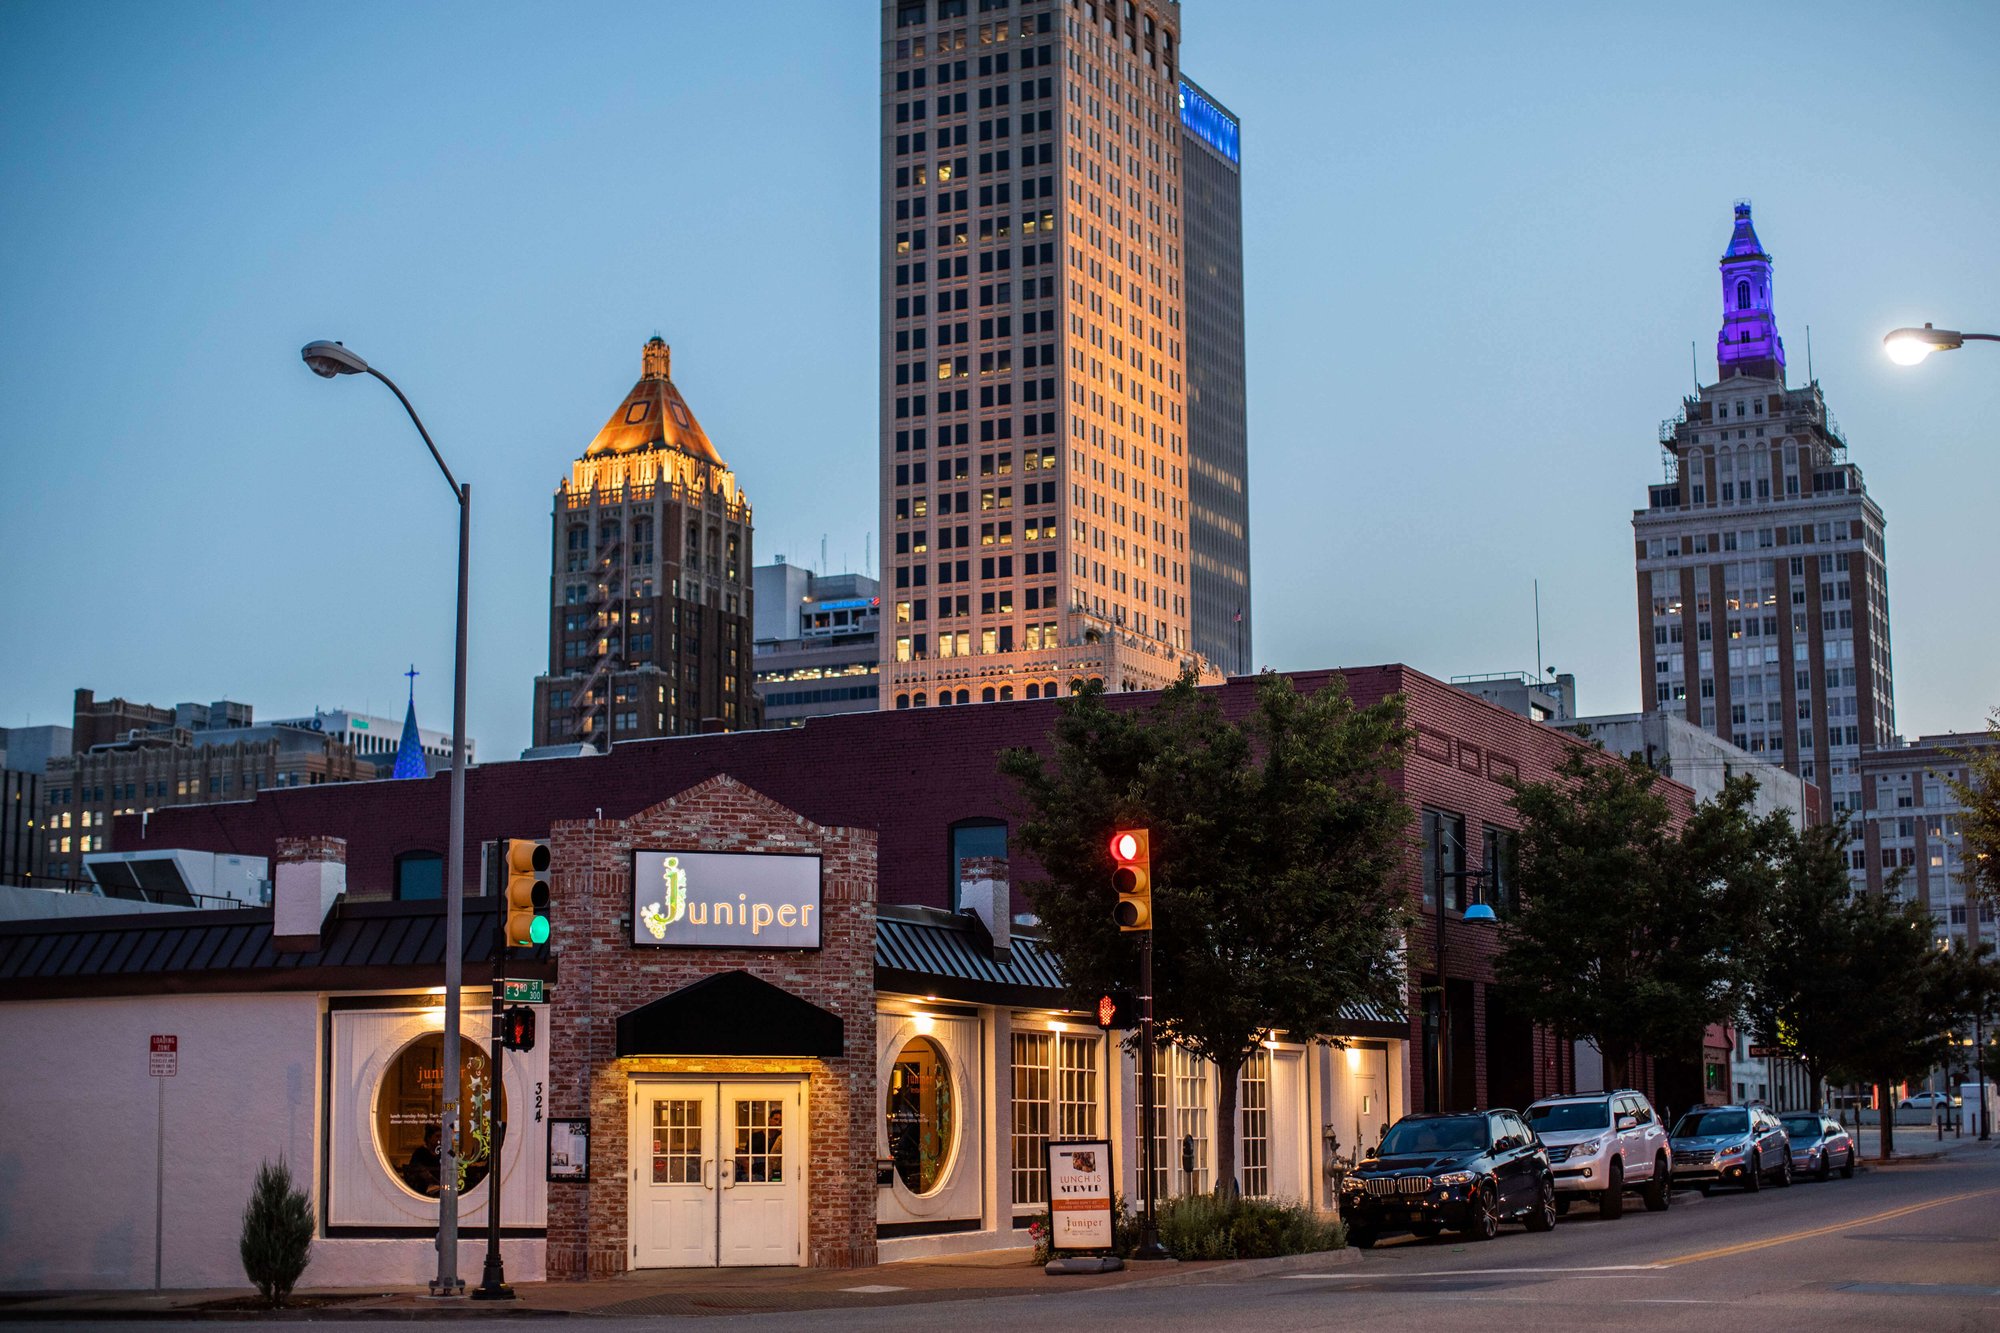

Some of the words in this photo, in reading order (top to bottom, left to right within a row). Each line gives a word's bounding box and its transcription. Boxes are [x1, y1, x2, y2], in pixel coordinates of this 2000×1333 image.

[506, 985, 511, 995] E
[514, 983, 528, 997] 3RD
[531, 981, 538, 991] ST
[530, 991, 540, 1000] 300
[417, 1066, 466, 1082] junir
[1060, 1175, 1090, 1184] LUNCH
[1093, 1174, 1102, 1182] IS
[1061, 1184, 1102, 1193] SERVED
